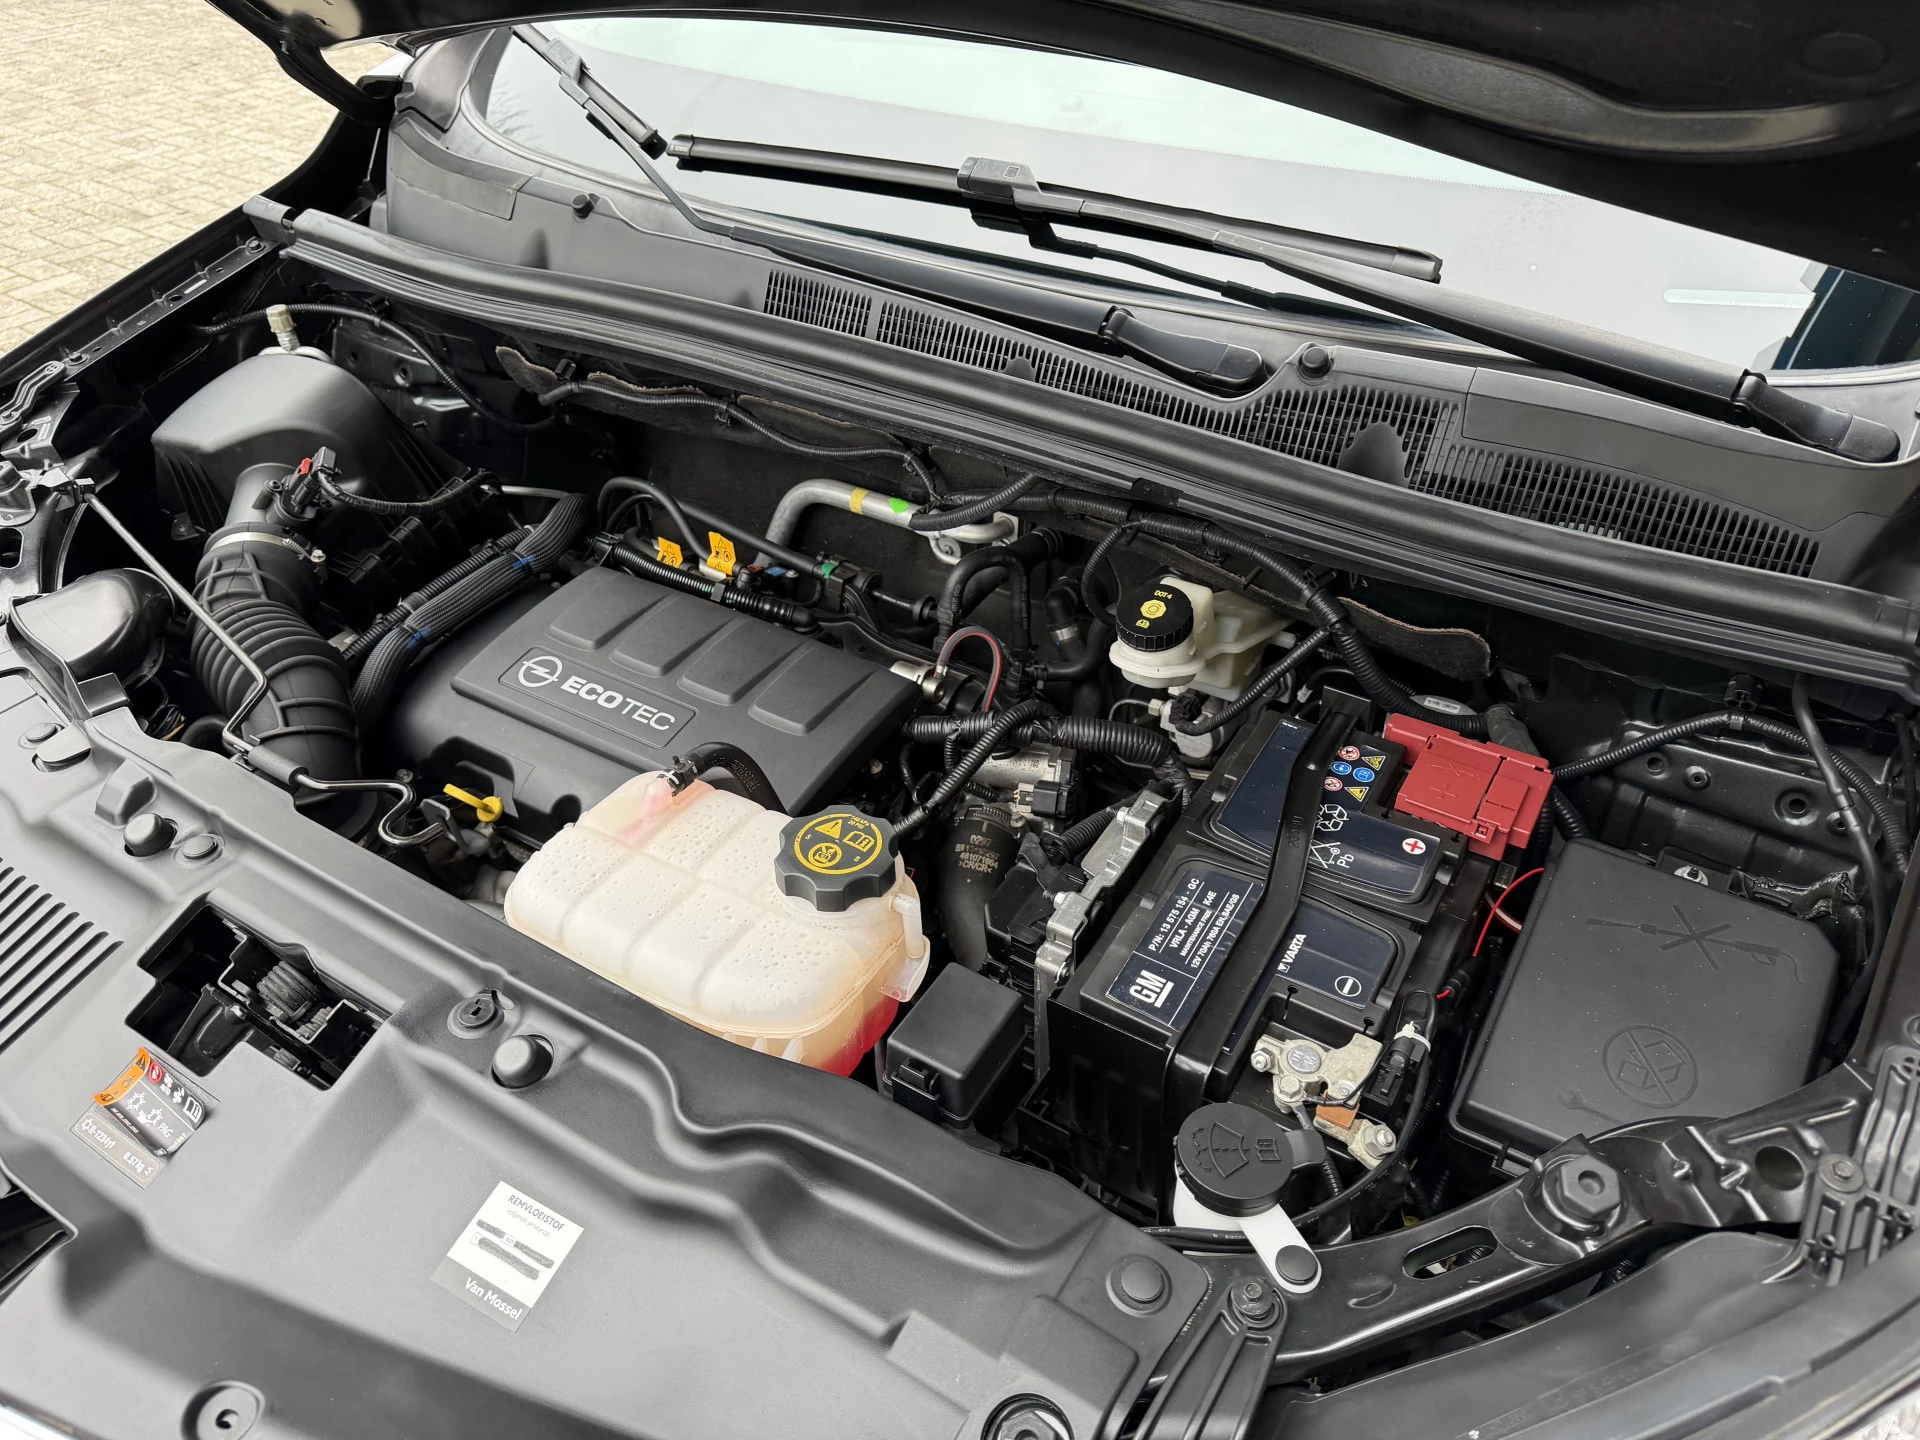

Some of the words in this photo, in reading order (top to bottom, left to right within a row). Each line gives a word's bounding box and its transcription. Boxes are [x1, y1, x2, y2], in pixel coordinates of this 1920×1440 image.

[560, 675, 676, 731] ECOTEC
[1337, 854, 1355, 869] Pb
[1148, 930, 1166, 951] P/N:
[1160, 923, 1170, 933] 13
[1168, 909, 1180, 923] 575
[1177, 895, 1189, 909] 154
[1188, 878, 1200, 890] GC
[1203, 890, 1218, 907] K4E
[1169, 928, 1188, 948] VRLA
[1185, 907, 1201, 926] AGM
[1180, 920, 1203, 957] MAINTENANCE
[1201, 910, 1213, 923] FREE
[1190, 955, 1203, 969] 12V
[1281, 933, 1307, 964] VARTA
[1129, 969, 1167, 1005] GM
[157, 1123, 174, 1138] PAG
[508, 1194, 565, 1231] REMVLOEISTOF
[465, 1277, 485, 1297] Van
[483, 1290, 523, 1320] Mossel
